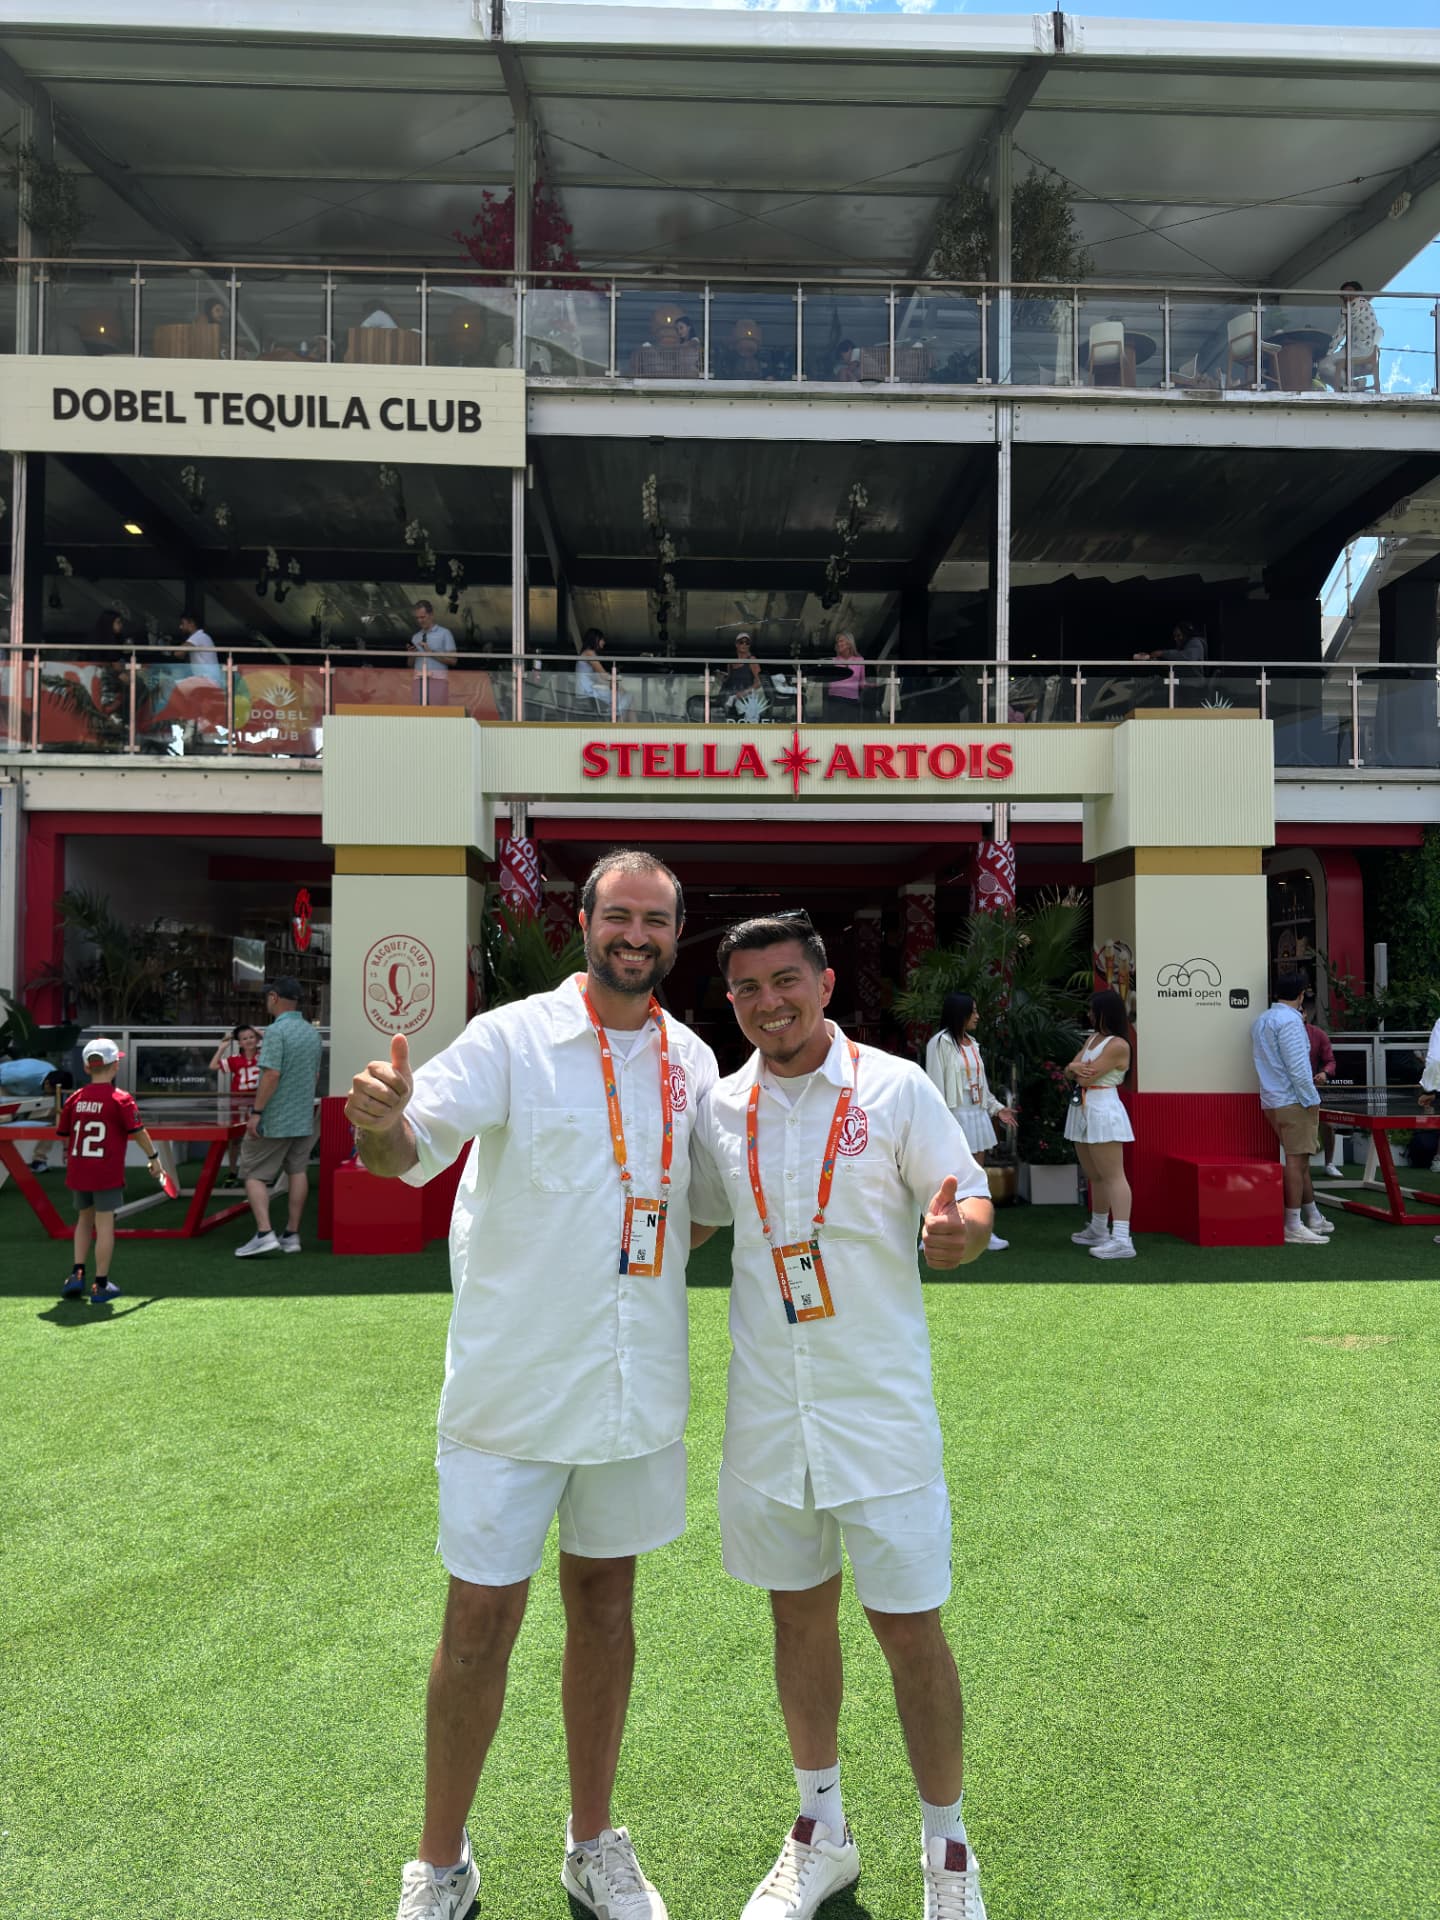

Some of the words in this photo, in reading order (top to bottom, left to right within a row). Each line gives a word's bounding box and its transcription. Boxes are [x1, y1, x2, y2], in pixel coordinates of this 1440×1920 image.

[53, 387, 187, 424] DOBEL
[194, 391, 371, 432] TEQUILA
[379, 397, 482, 433] CLUB
[251, 709, 308, 720] DOBEL
[582, 742, 769, 778] STELLA
[824, 743, 1015, 779] ARTOIS
[371, 941, 408, 967] RACQUET
[409, 945, 427, 968] CLUB
[1157, 987, 1193, 998] miami
[1194, 990, 1222, 1000] open
[238, 1066, 261, 1091] 15
[76, 1101, 103, 1114] BRADY
[71, 1120, 106, 1158] 12
[646, 1213, 657, 1228] N
[799, 1256, 812, 1271] N
